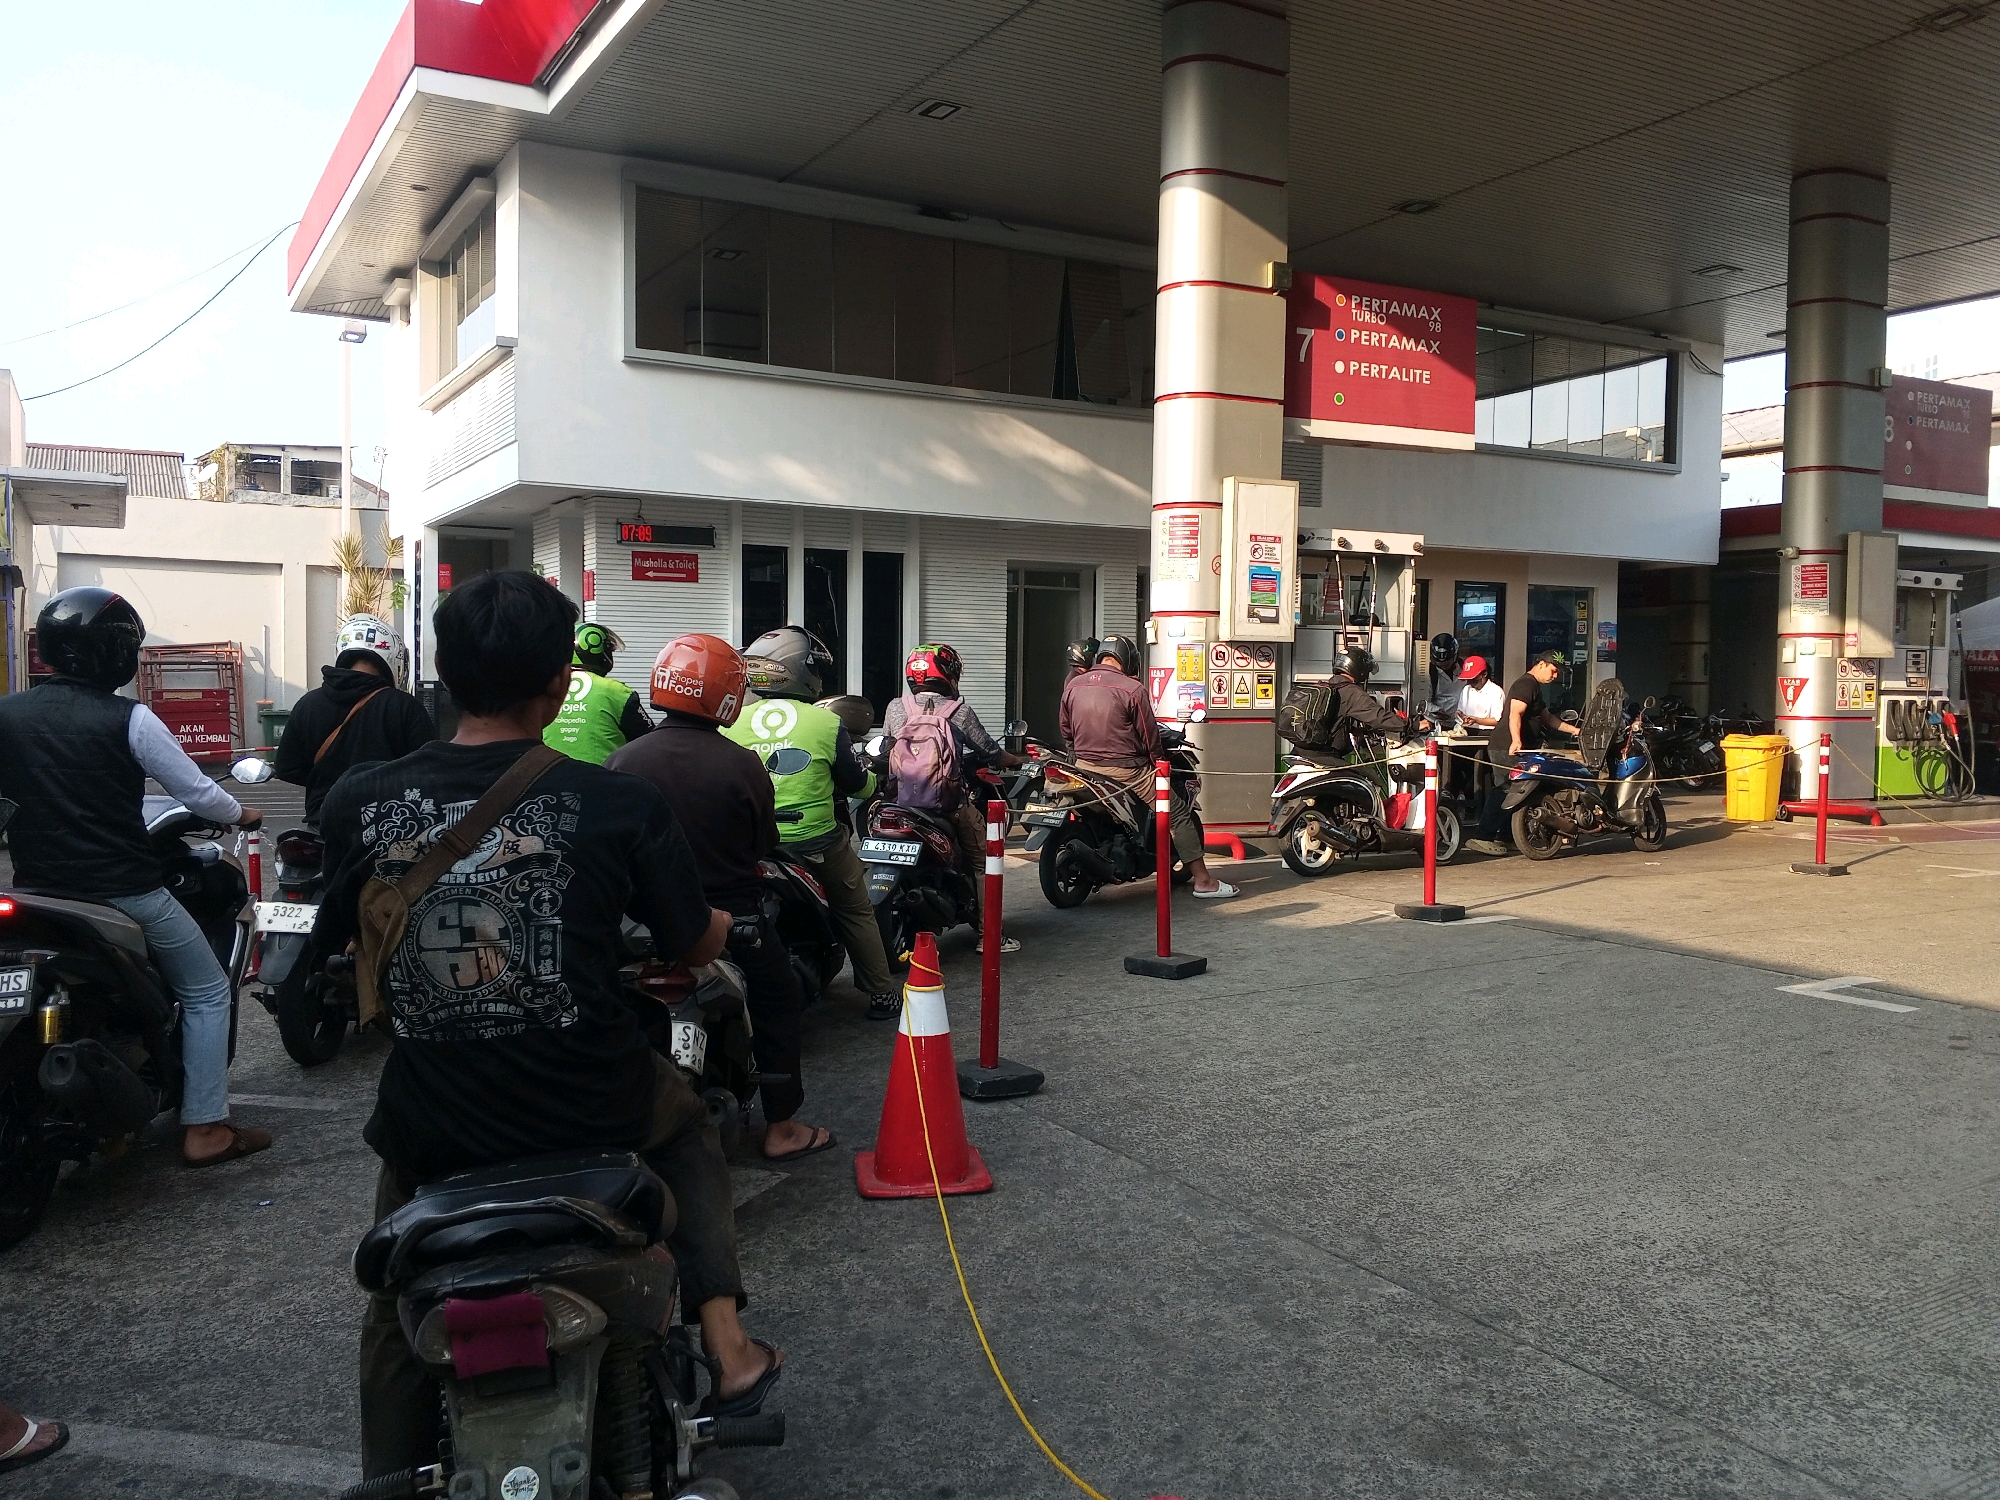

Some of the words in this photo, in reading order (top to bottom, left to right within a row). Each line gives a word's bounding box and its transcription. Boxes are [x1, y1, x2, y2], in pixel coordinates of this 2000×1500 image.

[1351, 295, 1442, 322] PERTAMAX
[1351, 309, 1387, 325] TURBO
[1428, 321, 1442, 333] 98
[1296, 327, 1315, 363] 7
[1350, 329, 1441, 354] PERTAMAX
[1349, 361, 1431, 385] PERTALITE
[1917, 391, 1971, 410] PERTAMAX
[1884, 415, 1895, 442] 8
[1916, 416, 1970, 434] PERTAMAX
[621, 524, 652, 542] 07:09
[634, 557, 667, 569] Musholla
[668, 559, 675, 569] &
[675, 560, 696, 570] Toilet
[670, 671, 704, 687] Shopee
[668, 680, 704, 698] Food
[179, 724, 205, 733] AKAN
[195, 734, 230, 744] KEMBALI
[469, 867, 509, 884] SEIYA
[272, 905, 303, 918] 5322
[439, 888, 472, 900] RAMEN
[484, 893, 520, 927] JAPANESE
[511, 932, 523, 962] GYOZA
[1, 974, 23, 992] HS
[463, 1001, 478, 1014] of
[479, 1001, 525, 1017] ramen
[478, 1022, 526, 1040] GROUP
[681, 1025, 706, 1051] SNZ
